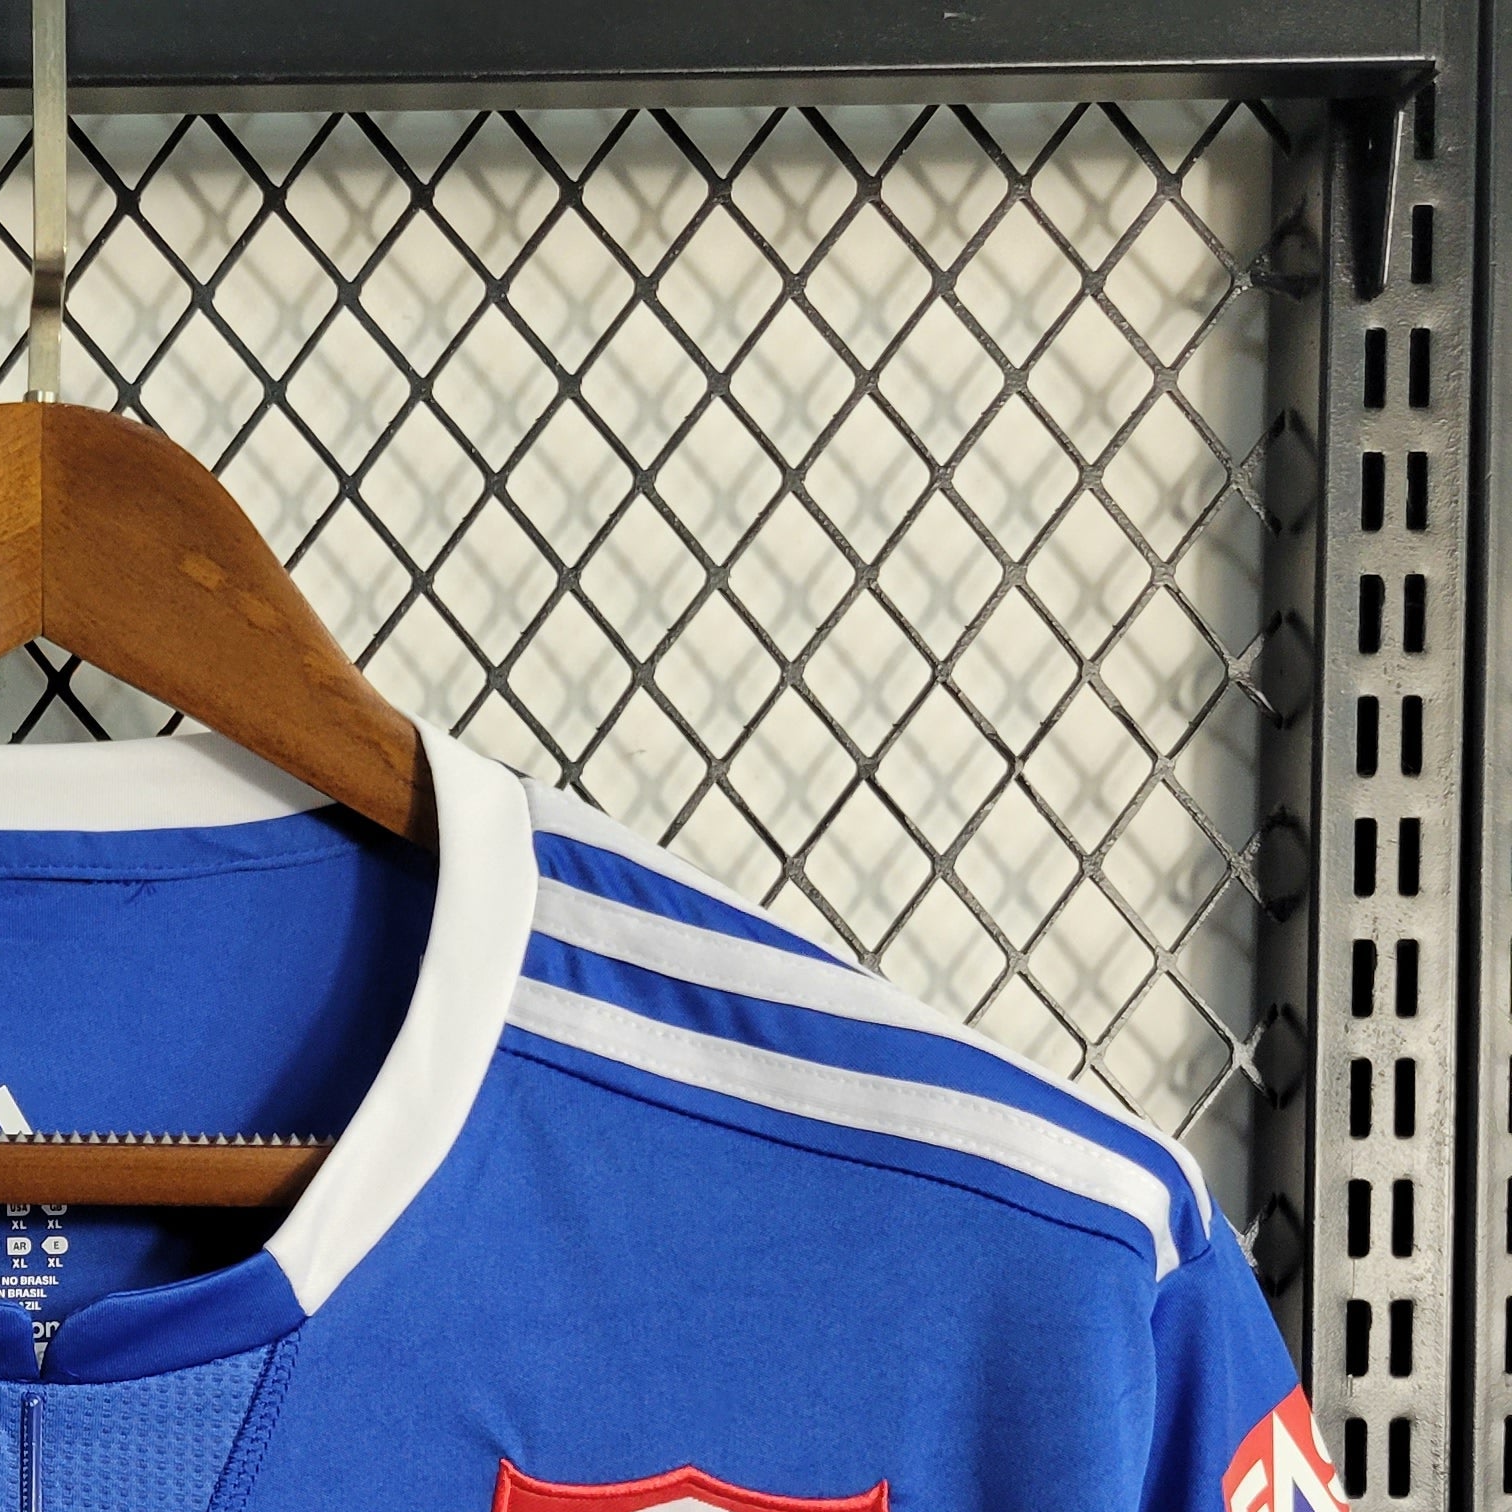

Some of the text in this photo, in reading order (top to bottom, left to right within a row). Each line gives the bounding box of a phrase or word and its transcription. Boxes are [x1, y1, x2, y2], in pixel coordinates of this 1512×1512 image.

[10, 1203, 27, 1212] USA
[11, 1220, 27, 1230] XL
[47, 1219, 62, 1229] XL
[13, 1241, 26, 1250] AR
[53, 1241, 59, 1249] E
[12, 1258, 28, 1268] XL
[47, 1258, 63, 1268] XL
[2, 1276, 18, 1286] NO
[20, 1275, 59, 1285] BRASIL
[8, 1288, 47, 1298] BRASIL
